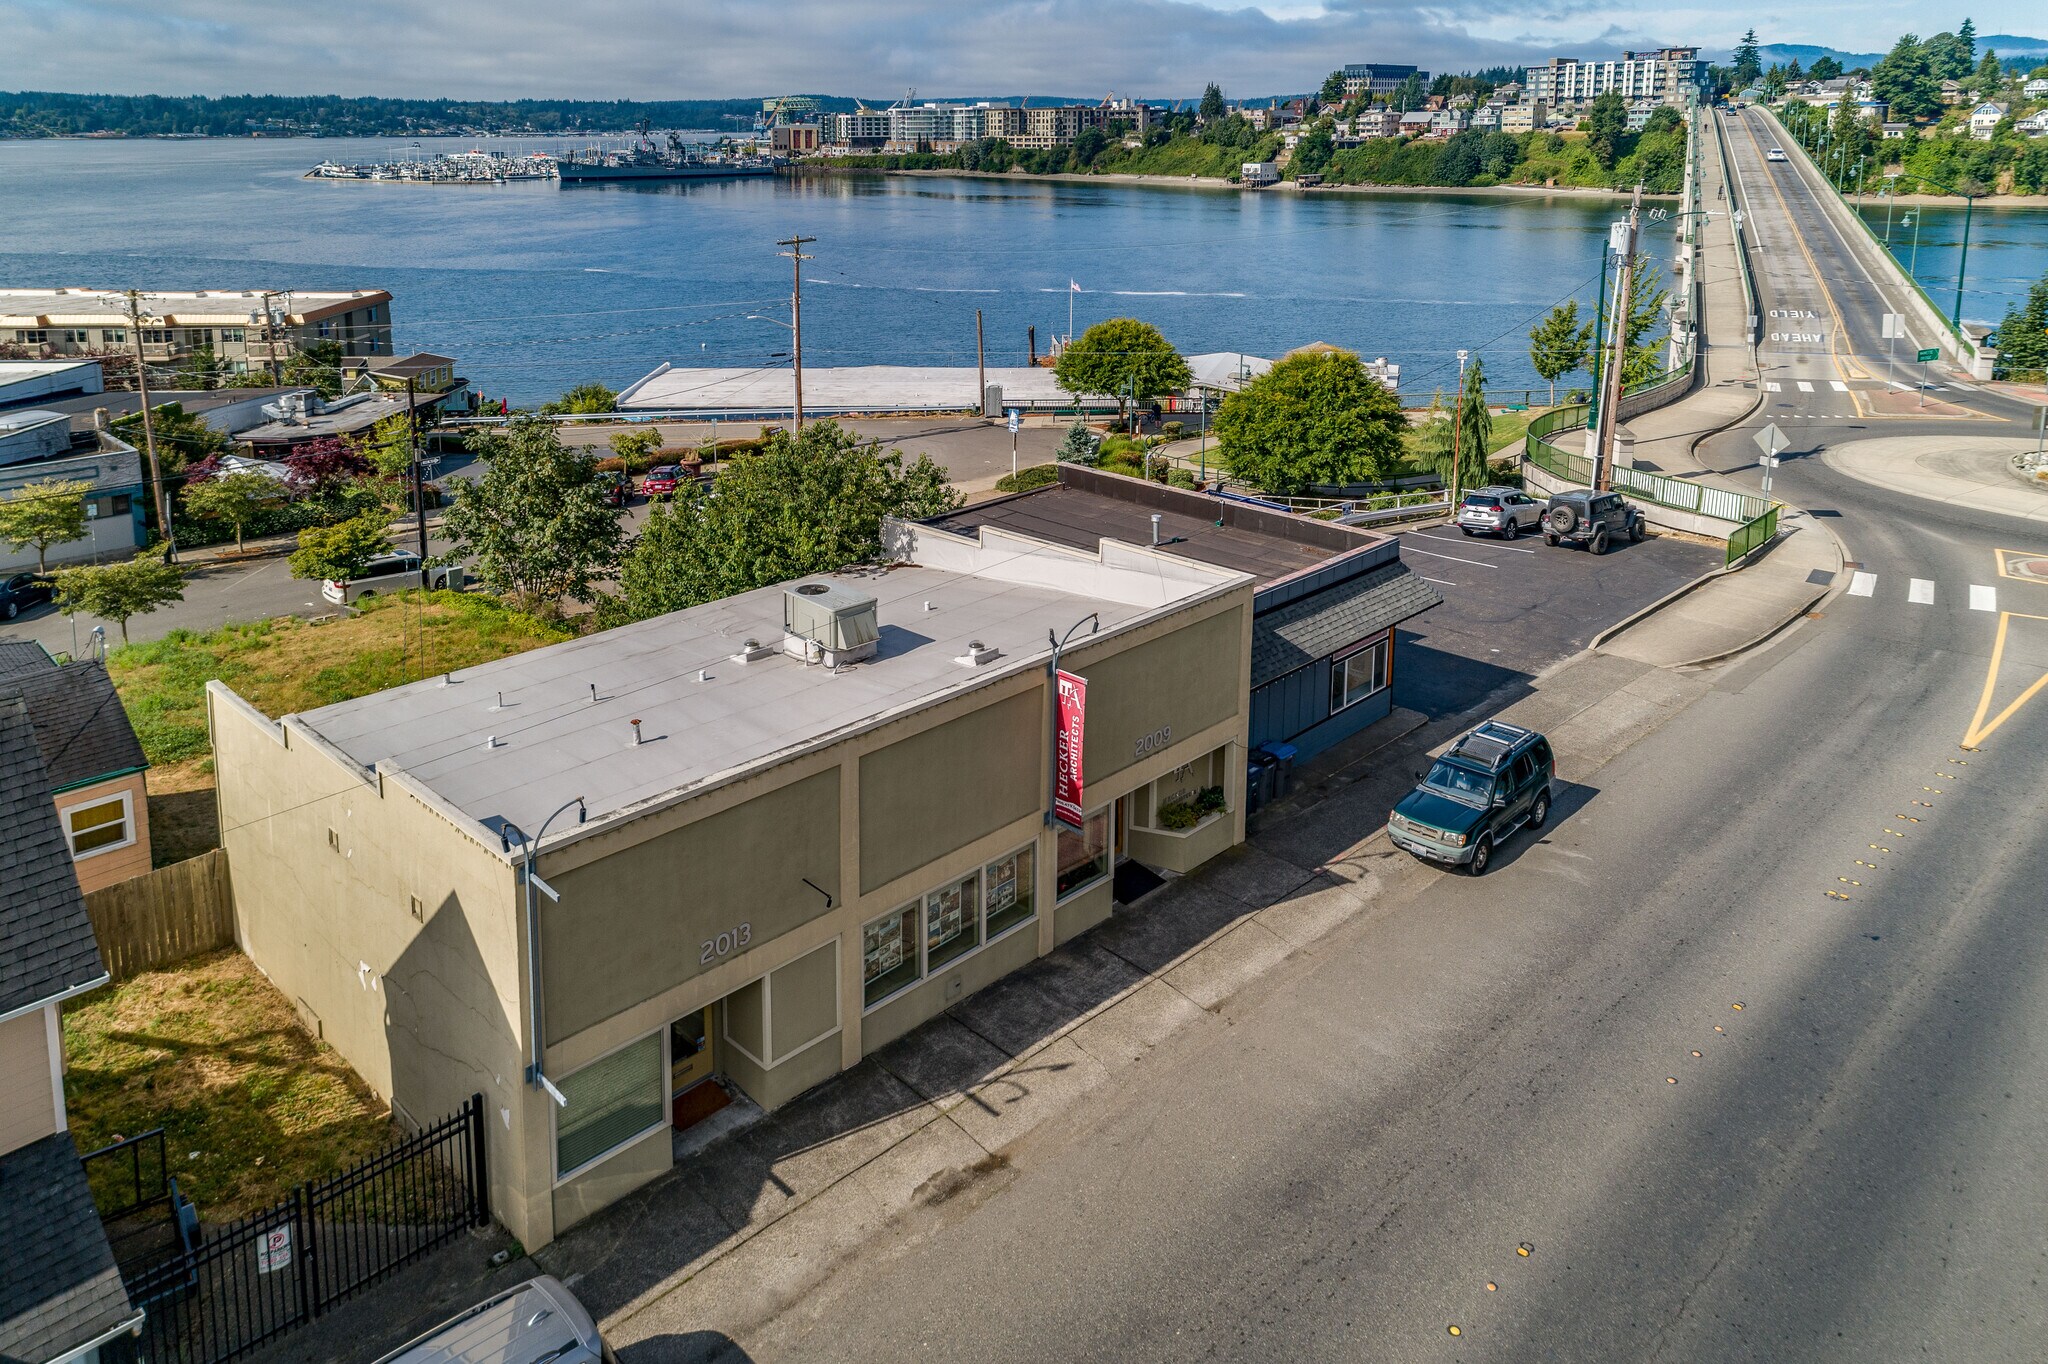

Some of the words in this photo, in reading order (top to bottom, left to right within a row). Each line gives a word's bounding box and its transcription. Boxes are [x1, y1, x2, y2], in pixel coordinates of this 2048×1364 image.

[1769, 309, 1815, 319] YIELD
[1771, 332, 1821, 343] AHEAD
[1070, 715, 1080, 782] ARCHITECTS
[1135, 726, 1171, 757] 2009
[1059, 730, 1069, 798] HECKER
[700, 922, 752, 965] 2013
